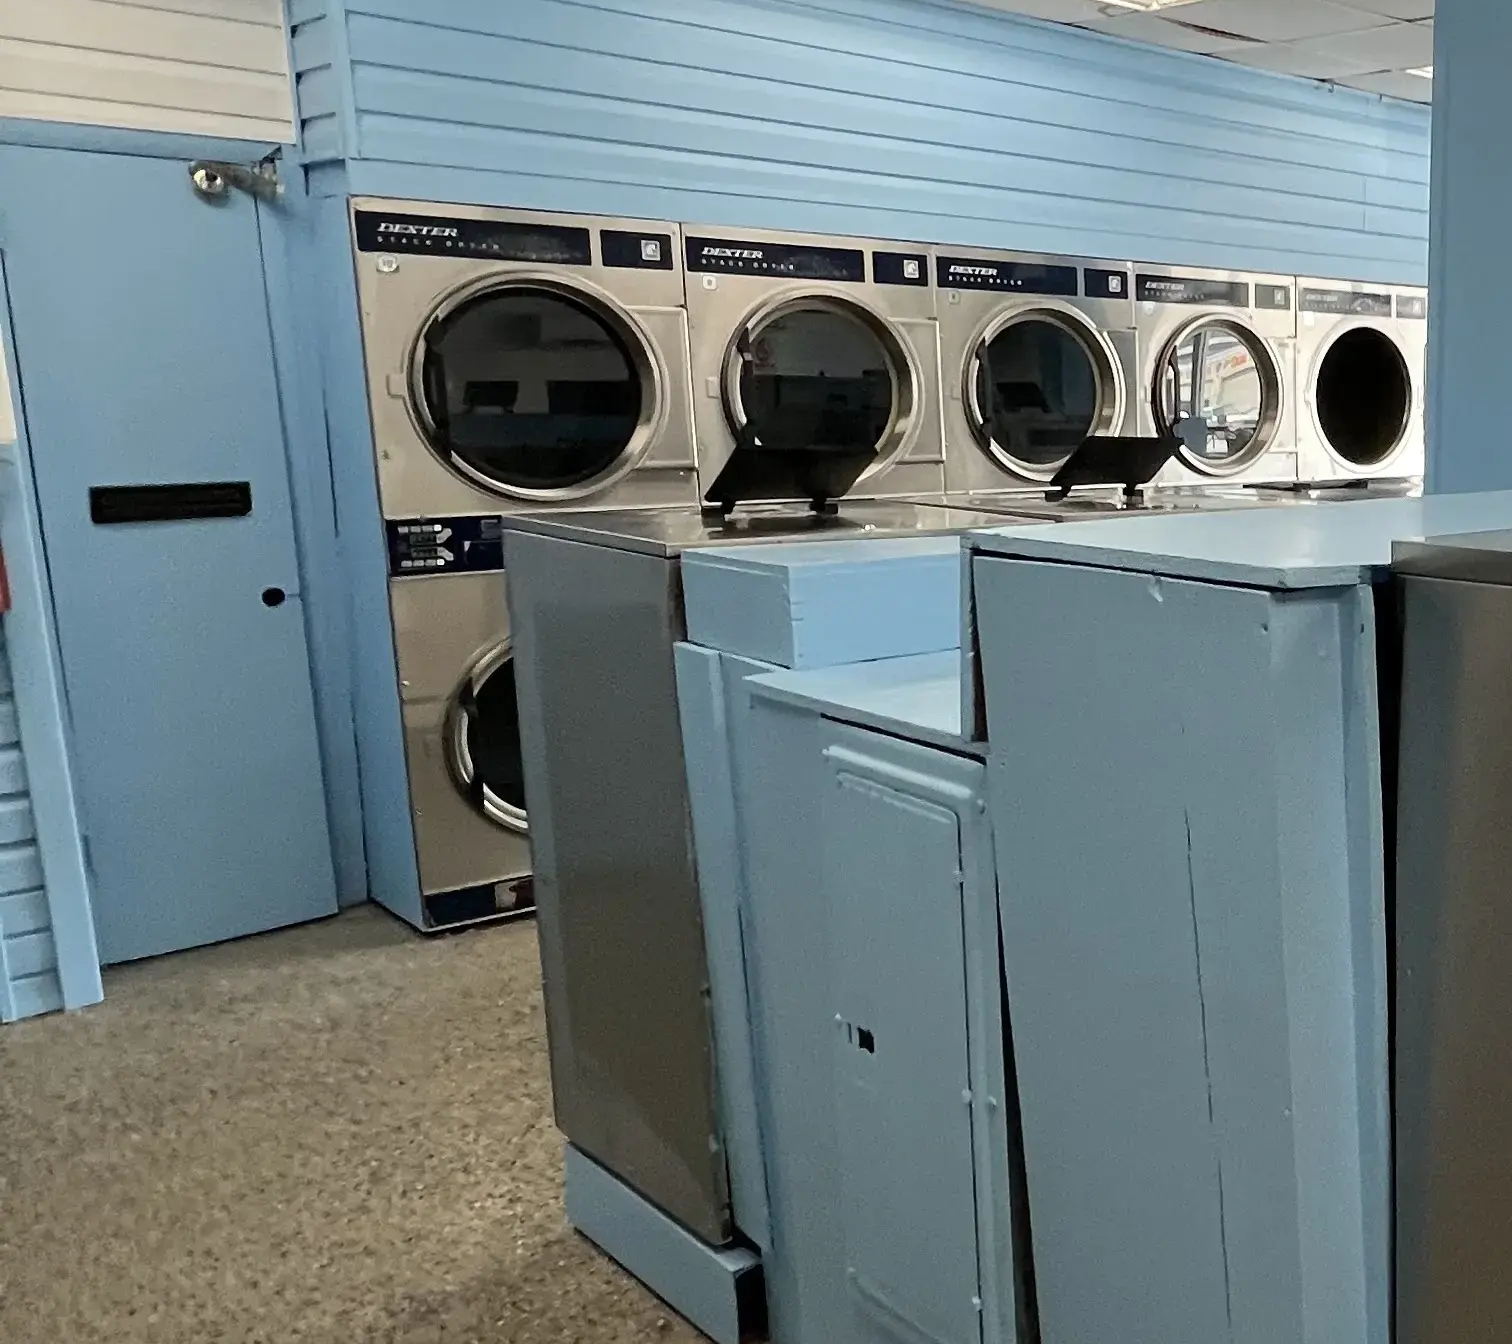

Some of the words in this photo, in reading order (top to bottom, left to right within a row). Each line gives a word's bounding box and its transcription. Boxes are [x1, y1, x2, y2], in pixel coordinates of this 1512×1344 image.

[376, 222, 458, 237] DEXTER
[701, 246, 763, 259] DEXTER
[948, 265, 998, 276] DEXTER
[1144, 281, 1185, 291] DEXTER
